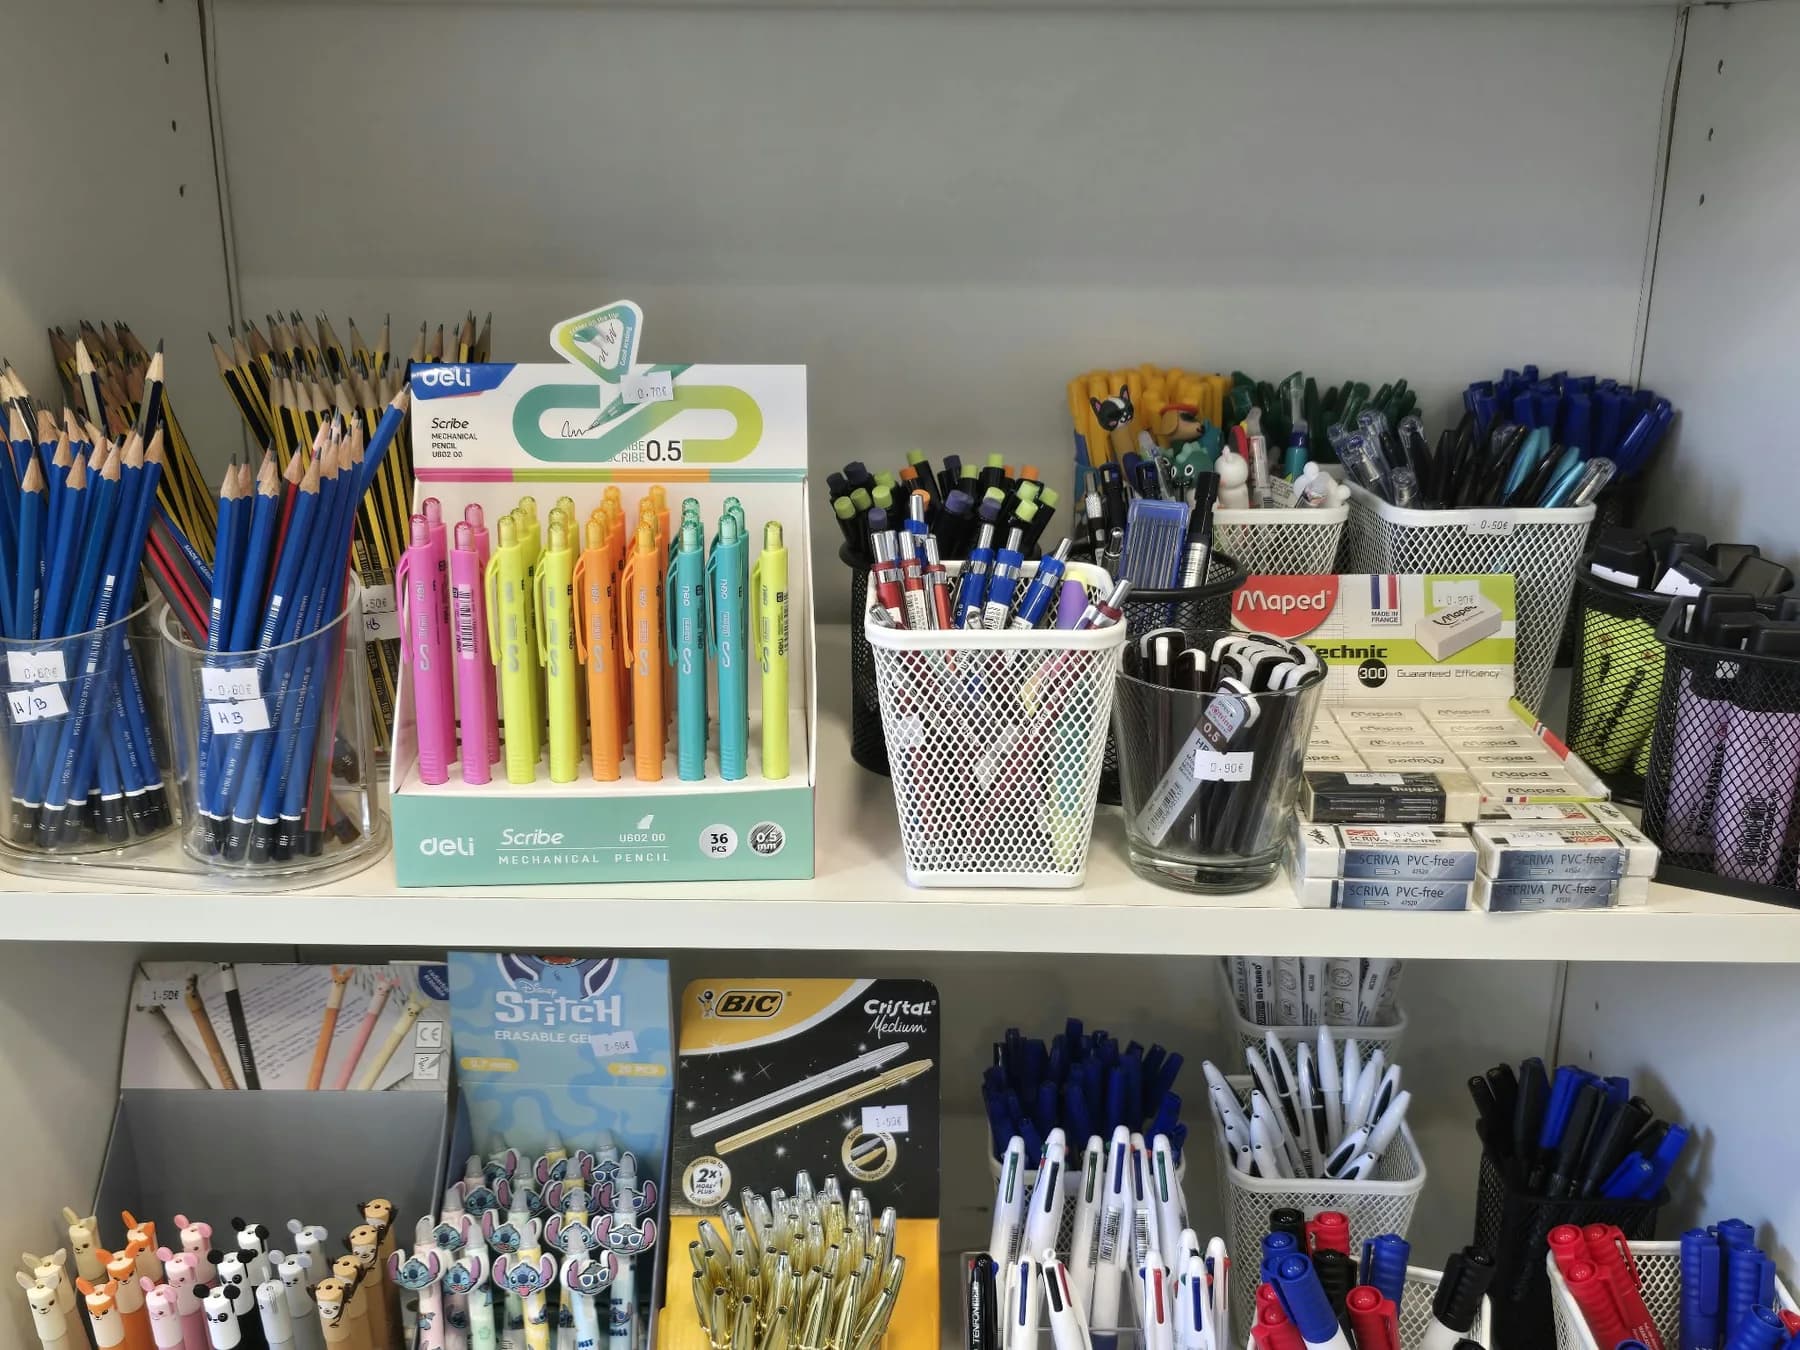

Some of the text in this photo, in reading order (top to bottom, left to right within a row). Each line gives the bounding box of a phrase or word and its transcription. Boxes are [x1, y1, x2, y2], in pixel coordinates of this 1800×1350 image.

[422, 366, 471, 387] deli
[431, 417, 470, 429] Scribe
[646, 440, 682, 461] 0.5
[1481, 520, 1508, 529] 0.50€
[1237, 590, 1325, 615] Maped
[1359, 667, 1387, 679] 300
[1397, 669, 1500, 679] Guaranteed Efficiency
[1210, 762, 1245, 773] 0.90€
[501, 829, 565, 845] Scribe
[710, 833, 728, 844] 36
[419, 837, 475, 856] deli
[499, 853, 669, 865] MECHANICAL PENCIL
[1359, 854, 1456, 866] SCRIVA PVC-free
[1516, 854, 1606, 865] SCRIVA PVC-free
[1350, 885, 1444, 898] SCRIVA PVC-free
[1508, 884, 1597, 895] SCRIVA PVC-free
[868, 1015, 926, 1038] Medium
[495, 1031, 565, 1043] ERASABLE
